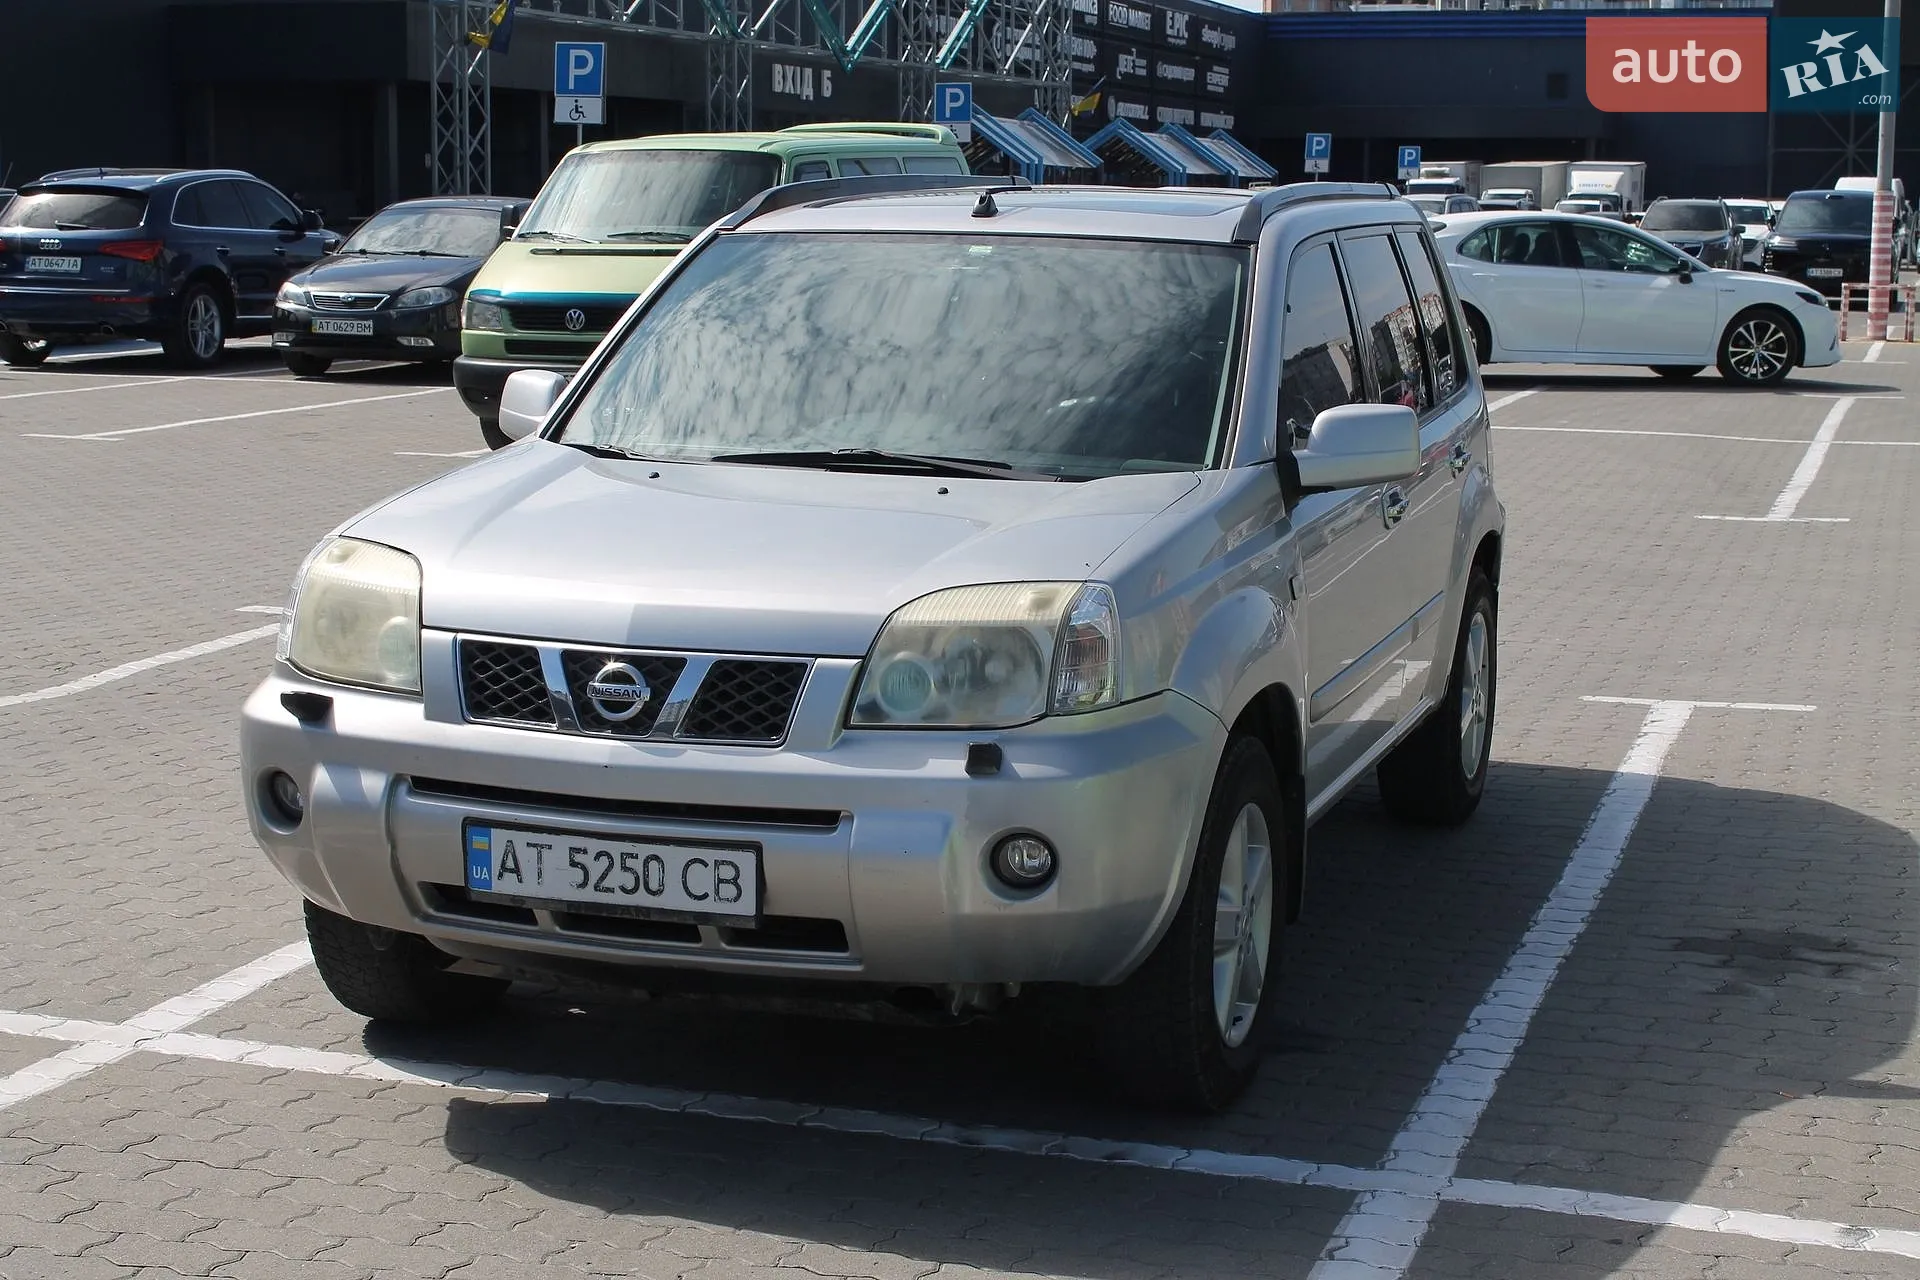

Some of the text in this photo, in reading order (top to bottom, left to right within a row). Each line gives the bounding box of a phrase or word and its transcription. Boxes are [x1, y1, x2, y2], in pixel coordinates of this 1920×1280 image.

[1109, 4, 1128, 24] FOOD
[568, 49, 594, 89] P
[772, 64, 832, 100] ВХІД Б
[945, 87, 965, 118] P
[1312, 136, 1326, 156] P
[1404, 148, 1416, 165] P
[31, 258, 43, 269] AT
[44, 259, 65, 270] 0647
[318, 321, 371, 333] AT 0629 BM
[591, 686, 642, 699] NISSAN
[472, 865, 490, 881] UA
[497, 839, 743, 904] AT 5250 CB
